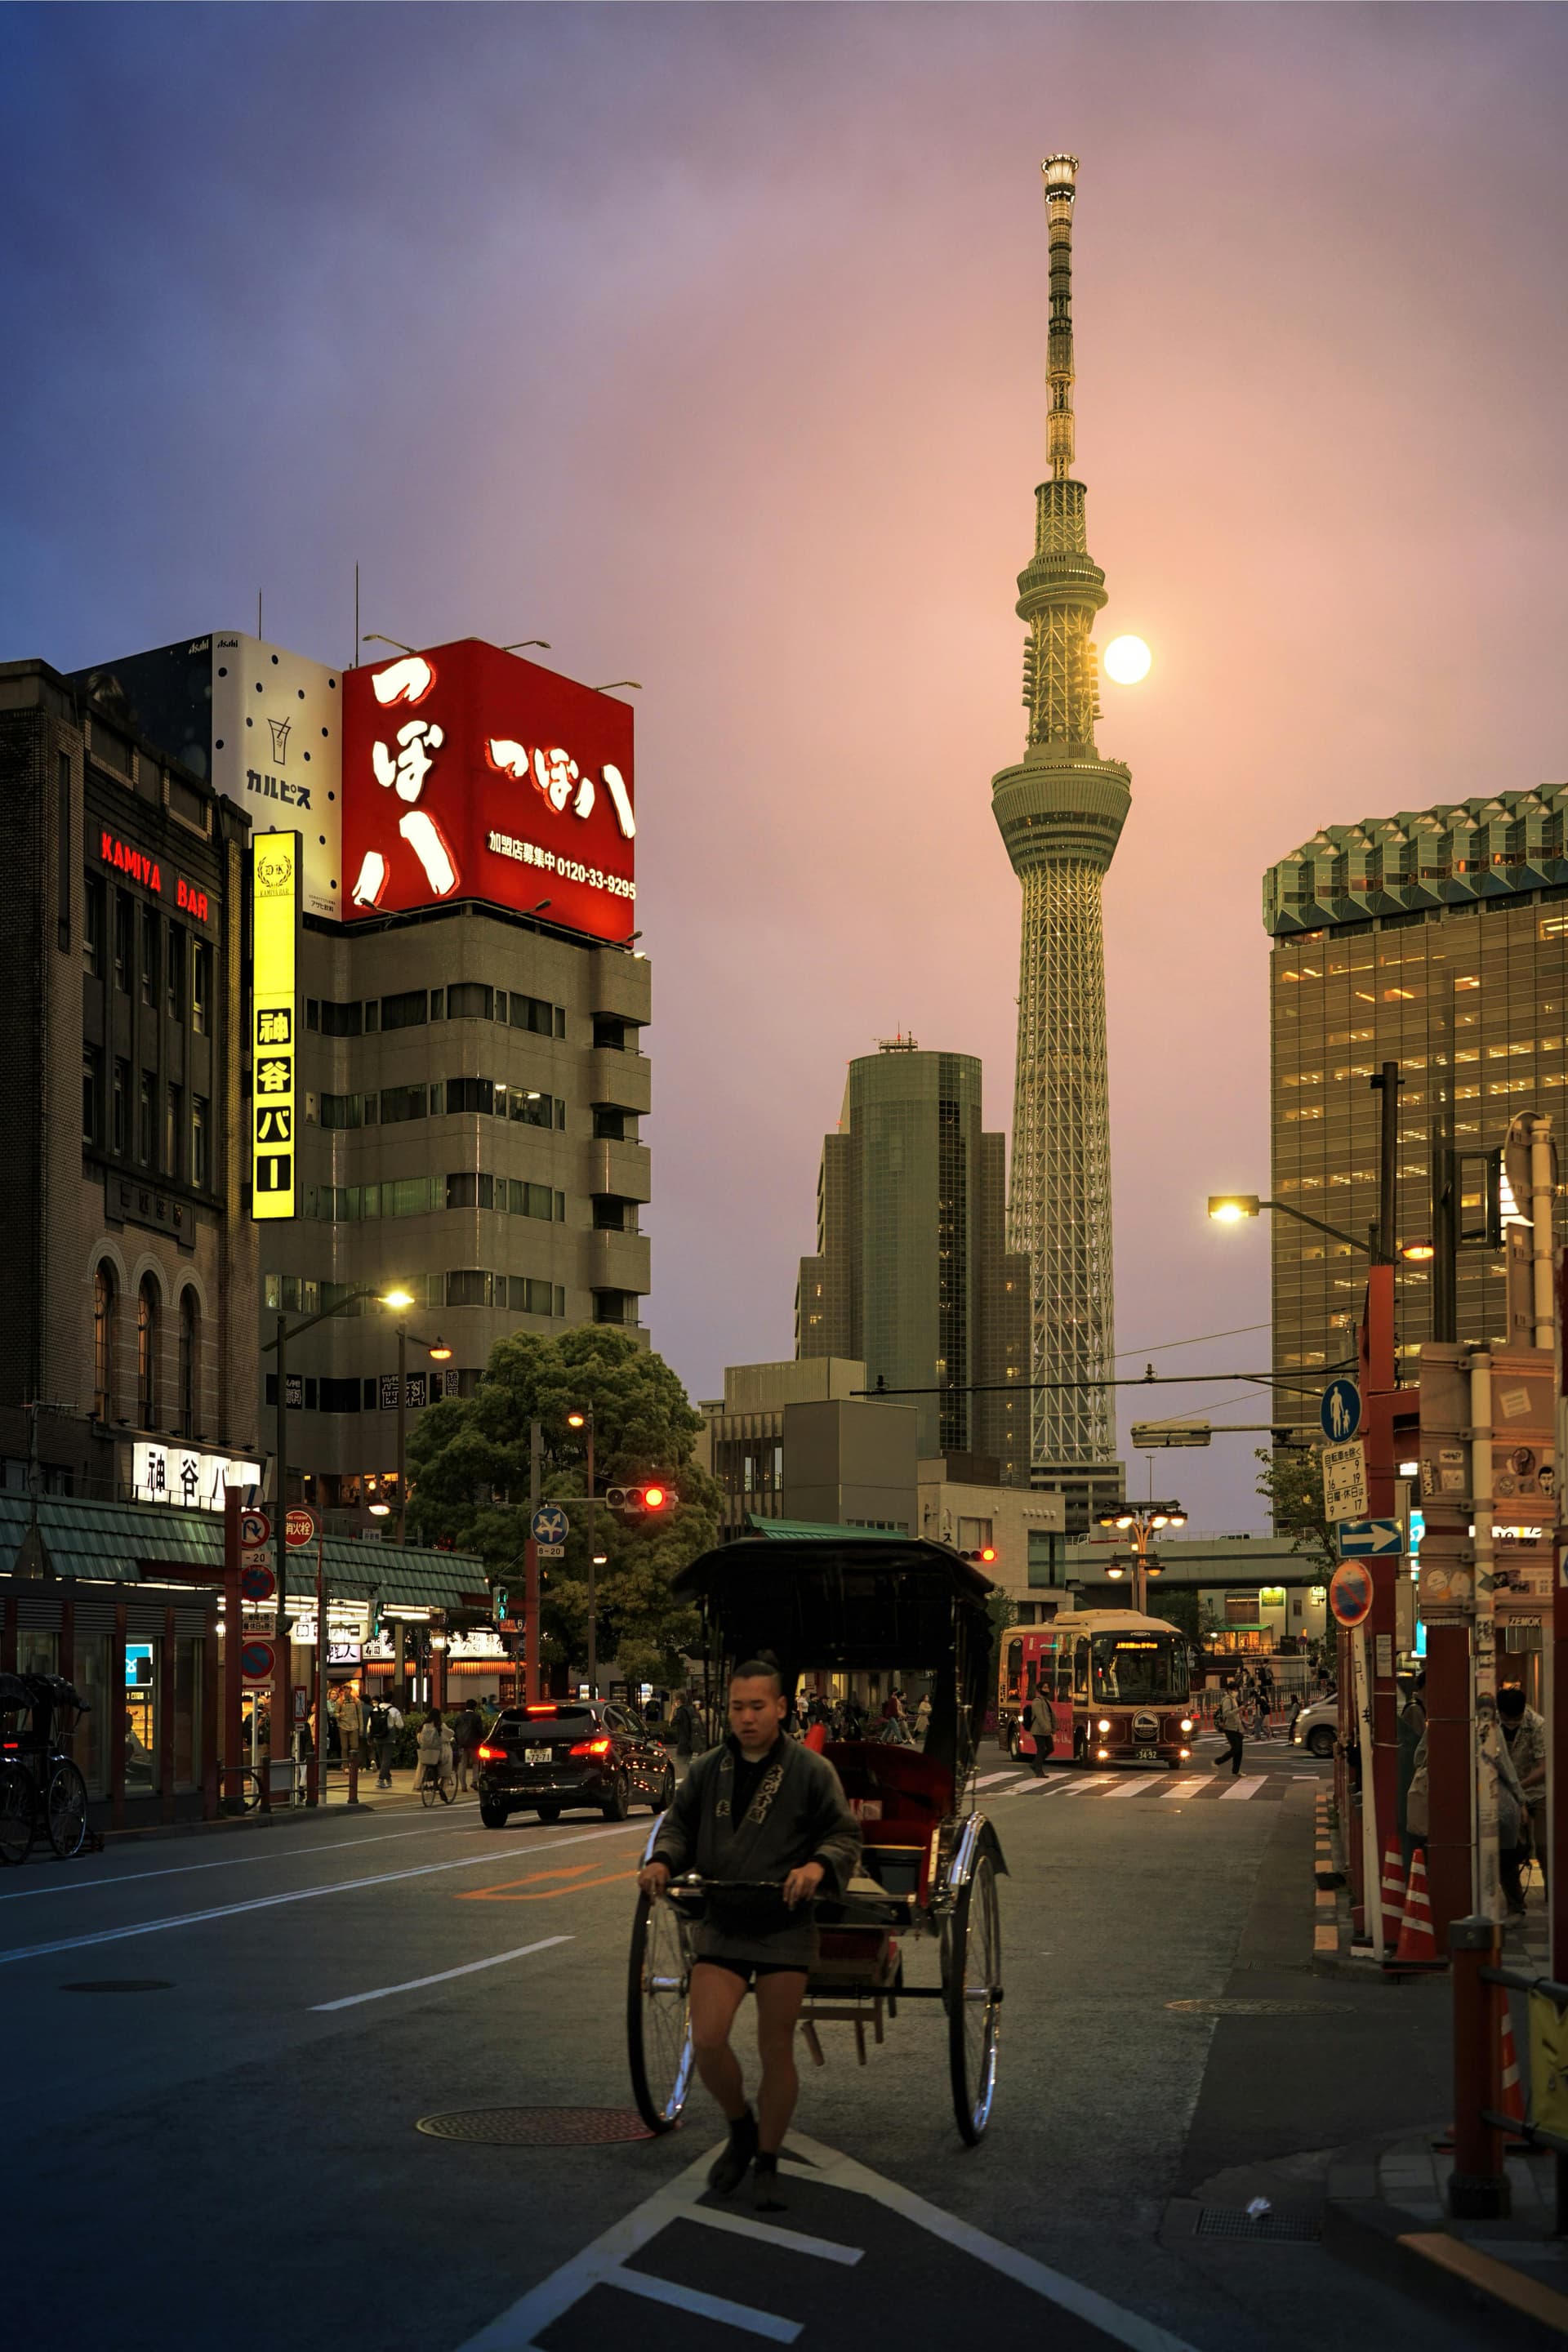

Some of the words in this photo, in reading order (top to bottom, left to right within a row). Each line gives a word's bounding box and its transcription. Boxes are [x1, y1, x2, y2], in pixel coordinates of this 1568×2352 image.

[217, 639, 238, 648] Asahi
[247, 769, 311, 810] カルピス
[351, 657, 460, 906] つぼ八
[489, 738, 637, 840] つぼ八
[102, 831, 161, 893] KAMIYA
[177, 879, 208, 922] BAR
[489, 831, 555, 871] 加盟店募集中
[557, 858, 637, 900] 0120-33-9295
[257, 1009, 292, 1191] 神谷バー
[148, 1452, 229, 1501] 神谷バ
[1325, 1447, 1361, 1465] 自転車を除く
[286, 1521, 311, 1535] 消火栓
[1508, 1616, 1541, 1628] ZEMOK
